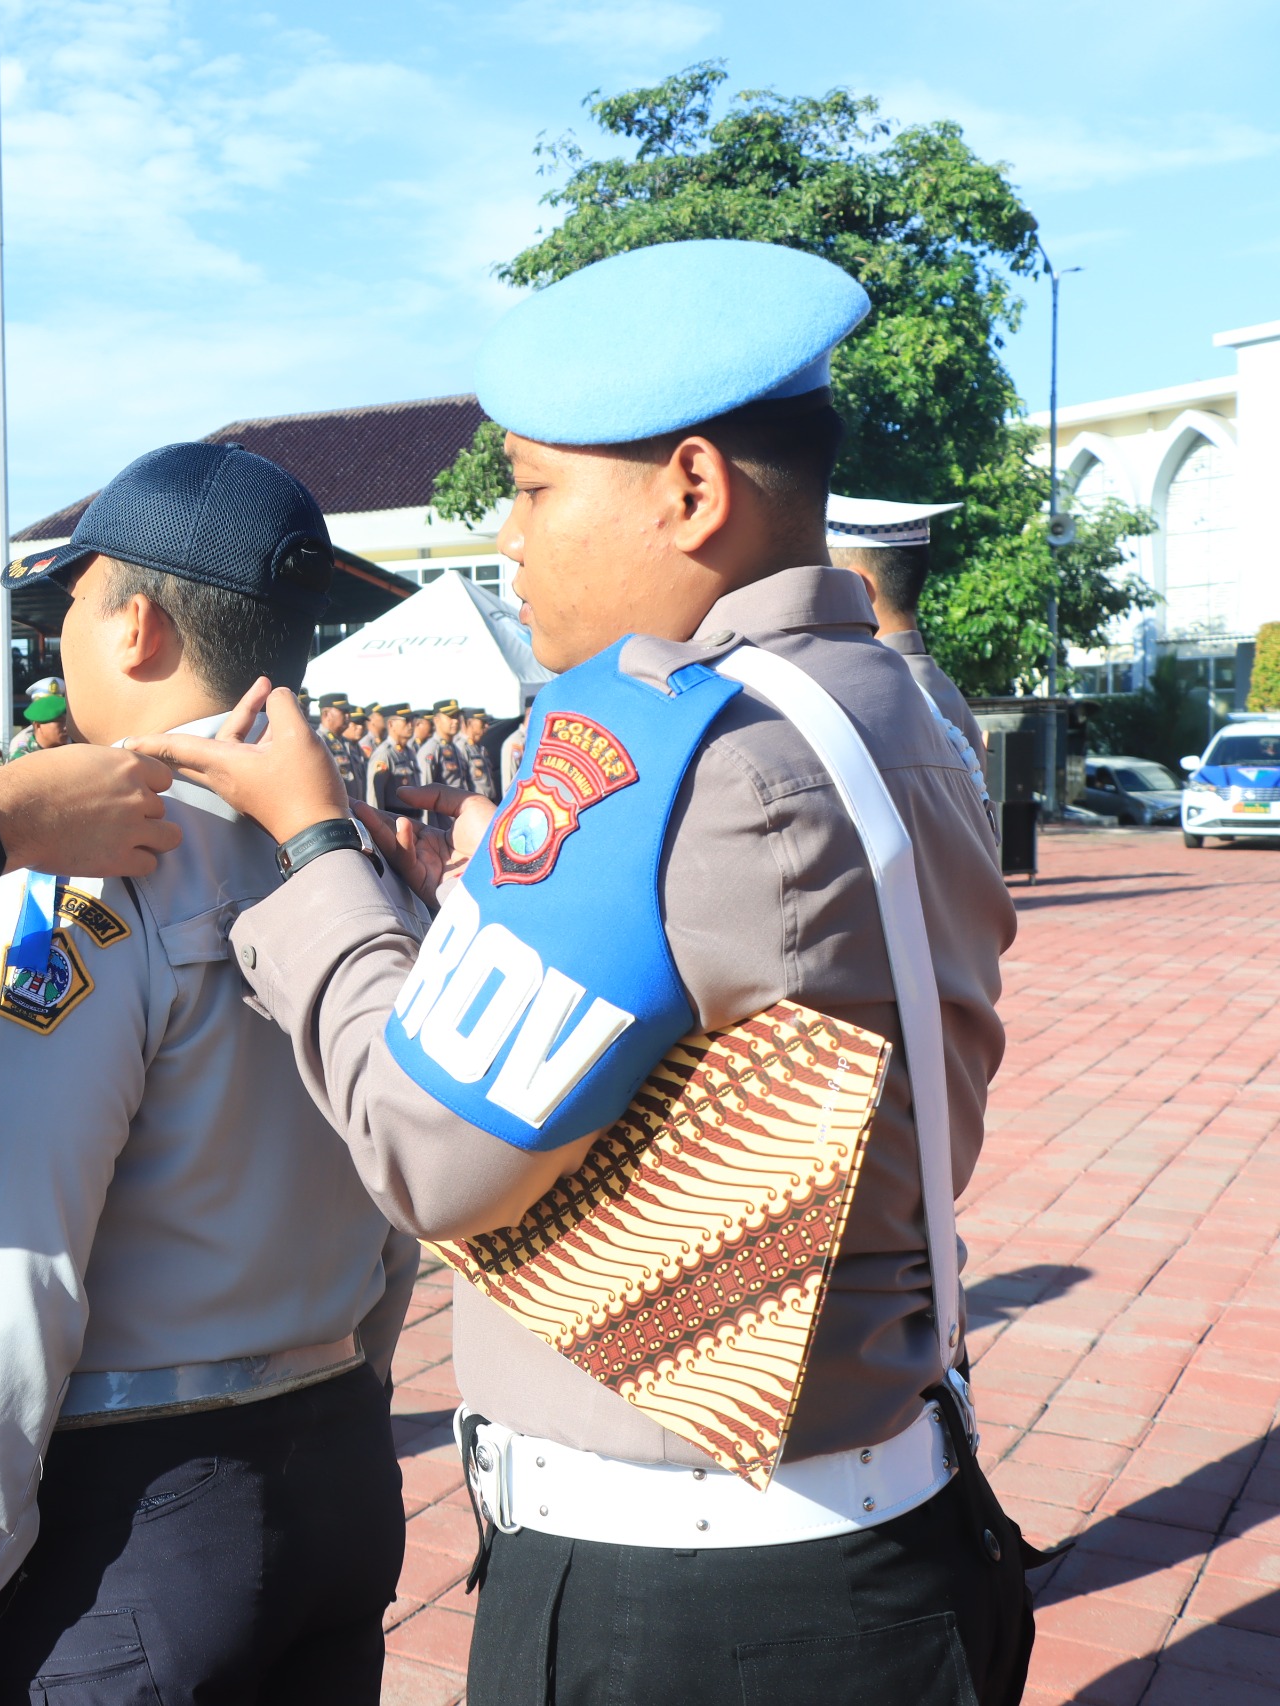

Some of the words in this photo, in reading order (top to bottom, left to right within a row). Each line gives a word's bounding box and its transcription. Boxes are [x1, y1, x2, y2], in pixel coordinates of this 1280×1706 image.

[553, 719, 626, 776] POLRES
[558, 730, 613, 777] GRESIK
[543, 755, 570, 776] JAWA
[569, 766, 593, 798] TIMUR
[65, 897, 116, 936] GRESIK
